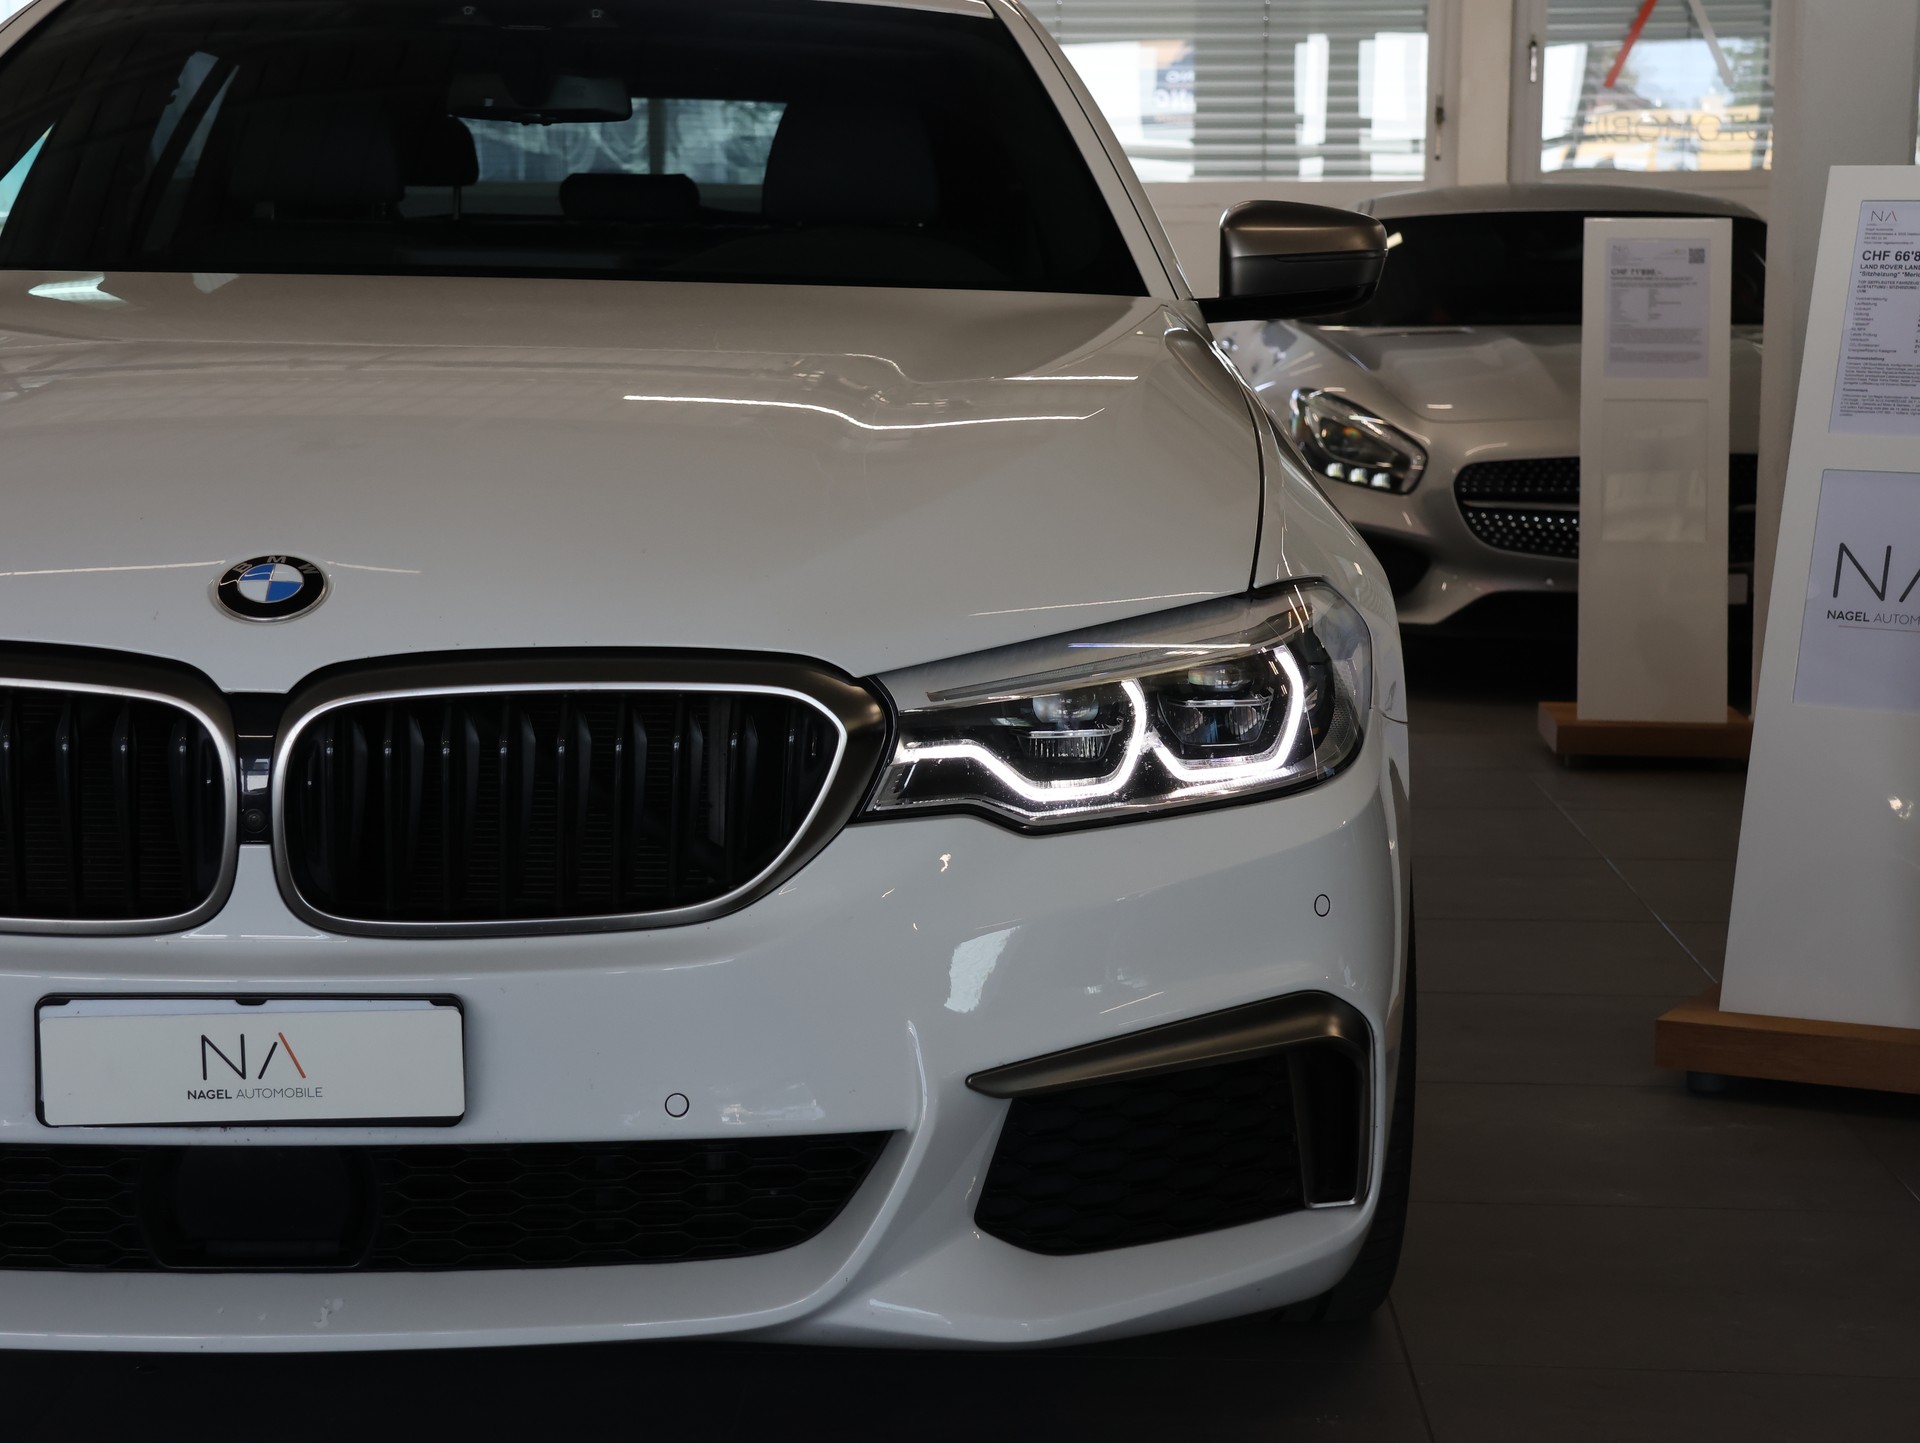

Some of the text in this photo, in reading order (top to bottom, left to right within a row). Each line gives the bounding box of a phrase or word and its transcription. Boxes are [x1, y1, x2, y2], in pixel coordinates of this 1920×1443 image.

[1862, 250, 1891, 261] CHF
[232, 555, 320, 575] BMW
[1827, 609, 1870, 623] NAGEL
[201, 1031, 306, 1081] NA
[187, 1086, 323, 1100] NAGEL AUTOMOBILE
